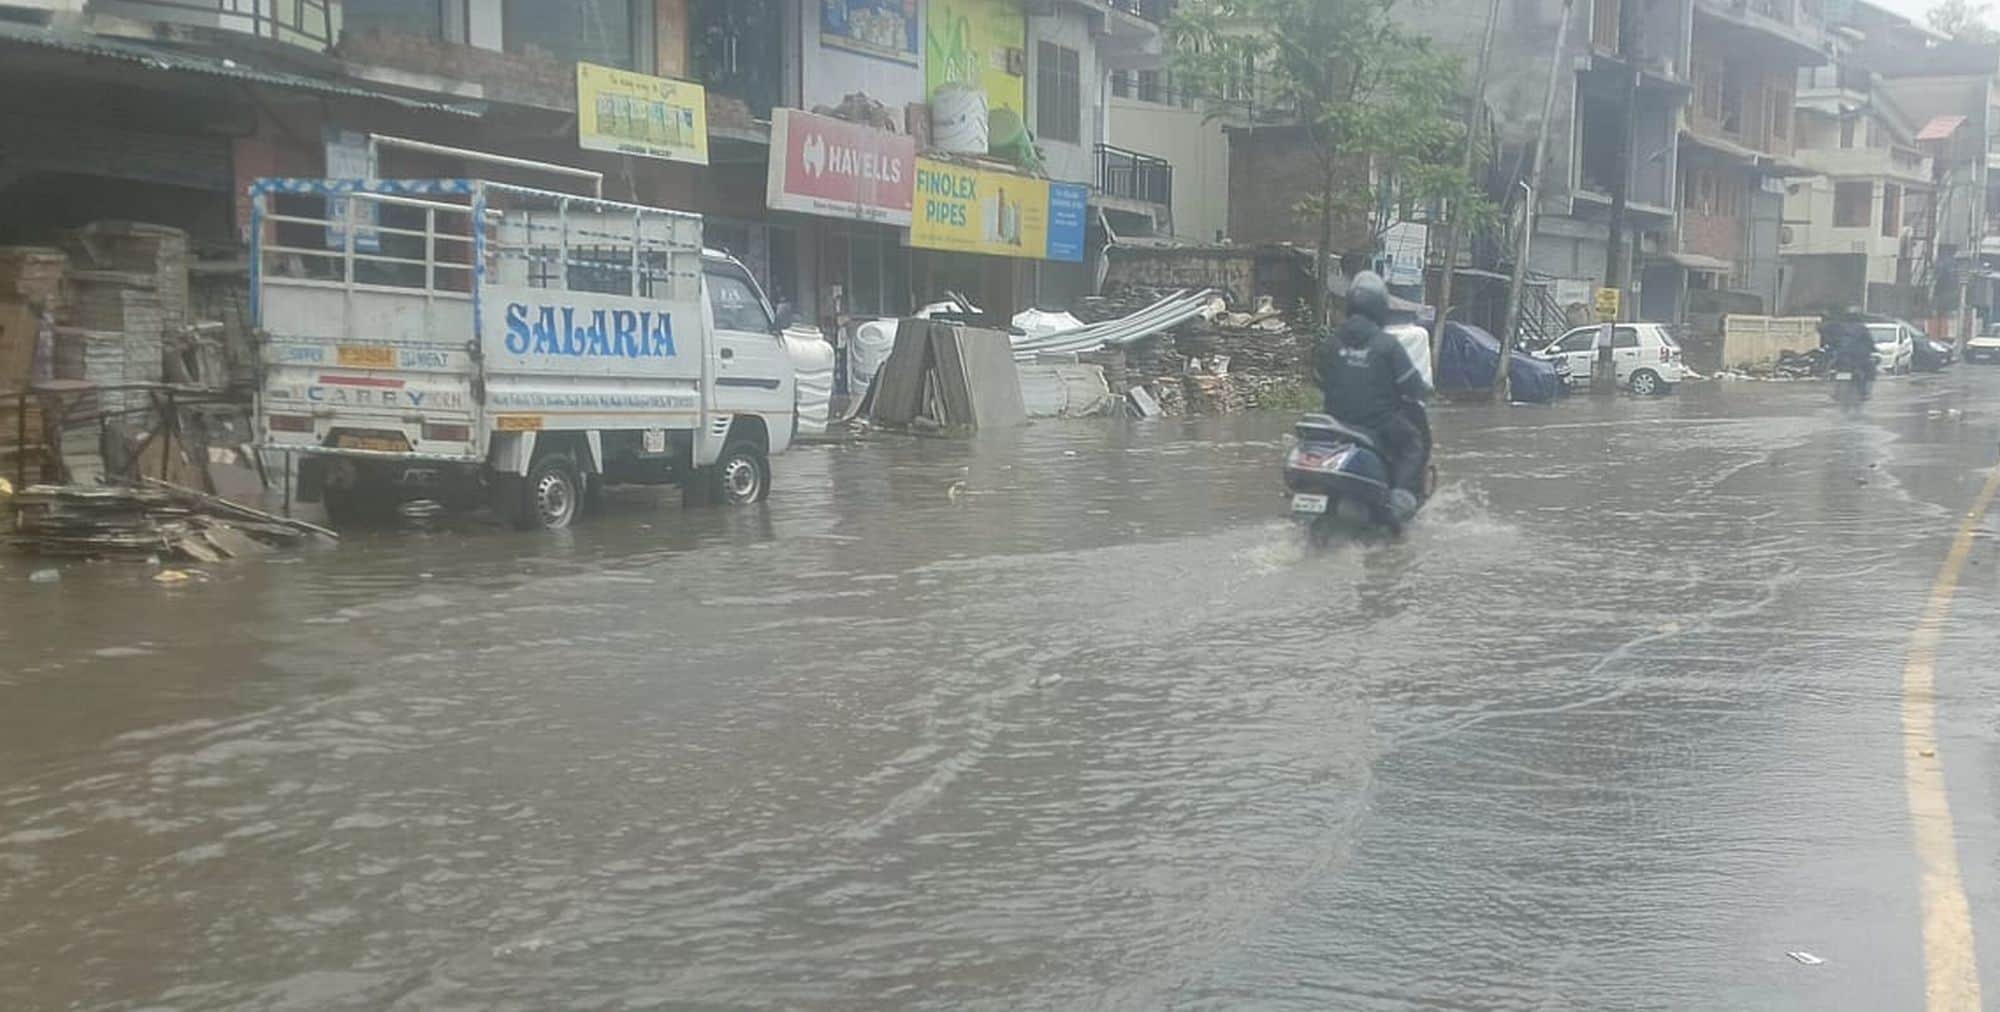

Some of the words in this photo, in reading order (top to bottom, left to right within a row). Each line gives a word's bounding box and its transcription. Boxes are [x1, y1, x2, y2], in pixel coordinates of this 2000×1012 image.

[829, 145, 900, 183] HAVELLS
[917, 169, 976, 200] FINOLEX
[926, 201, 967, 226] PIPES
[505, 302, 677, 358] SALARIA
[308, 386, 424, 406] CARRY
